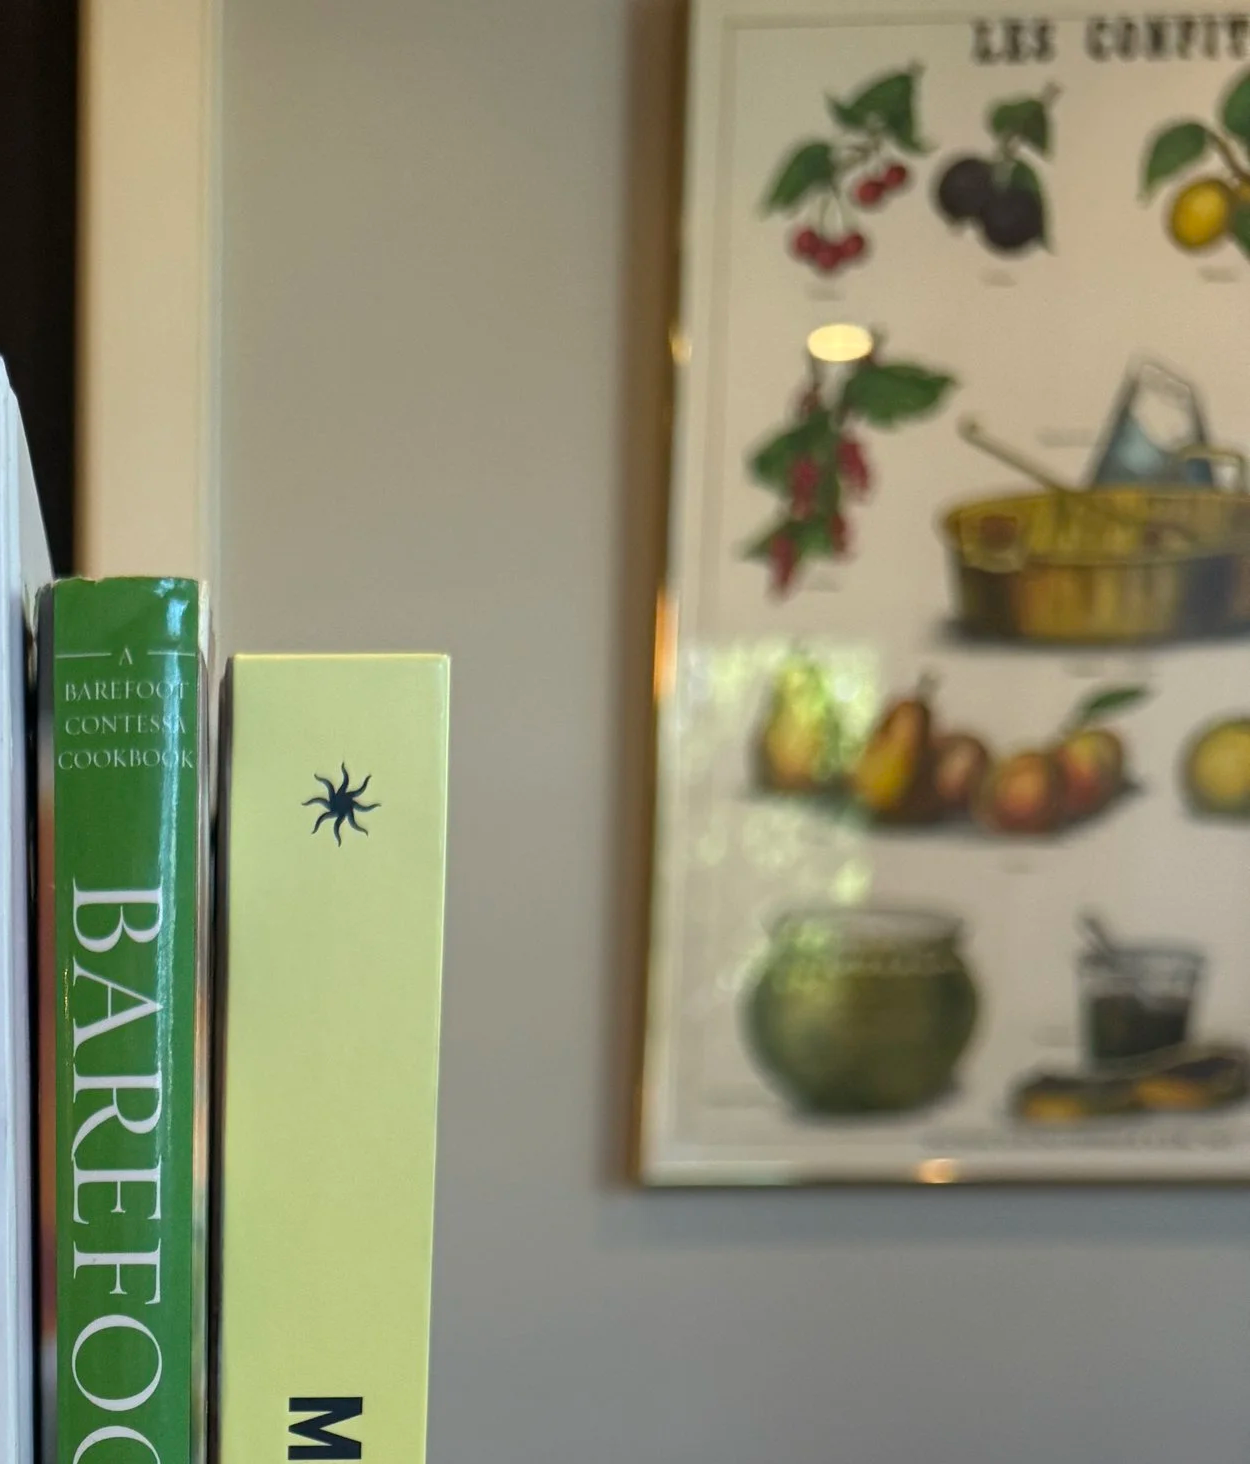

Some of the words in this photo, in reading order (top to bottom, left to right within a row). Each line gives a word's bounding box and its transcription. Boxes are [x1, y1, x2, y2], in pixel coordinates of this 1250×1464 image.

[119, 647, 133, 666] A
[65, 681, 189, 701] BAREFOOT
[65, 715, 186, 736] CONTESSA
[58, 749, 194, 770] COOKBOOK
